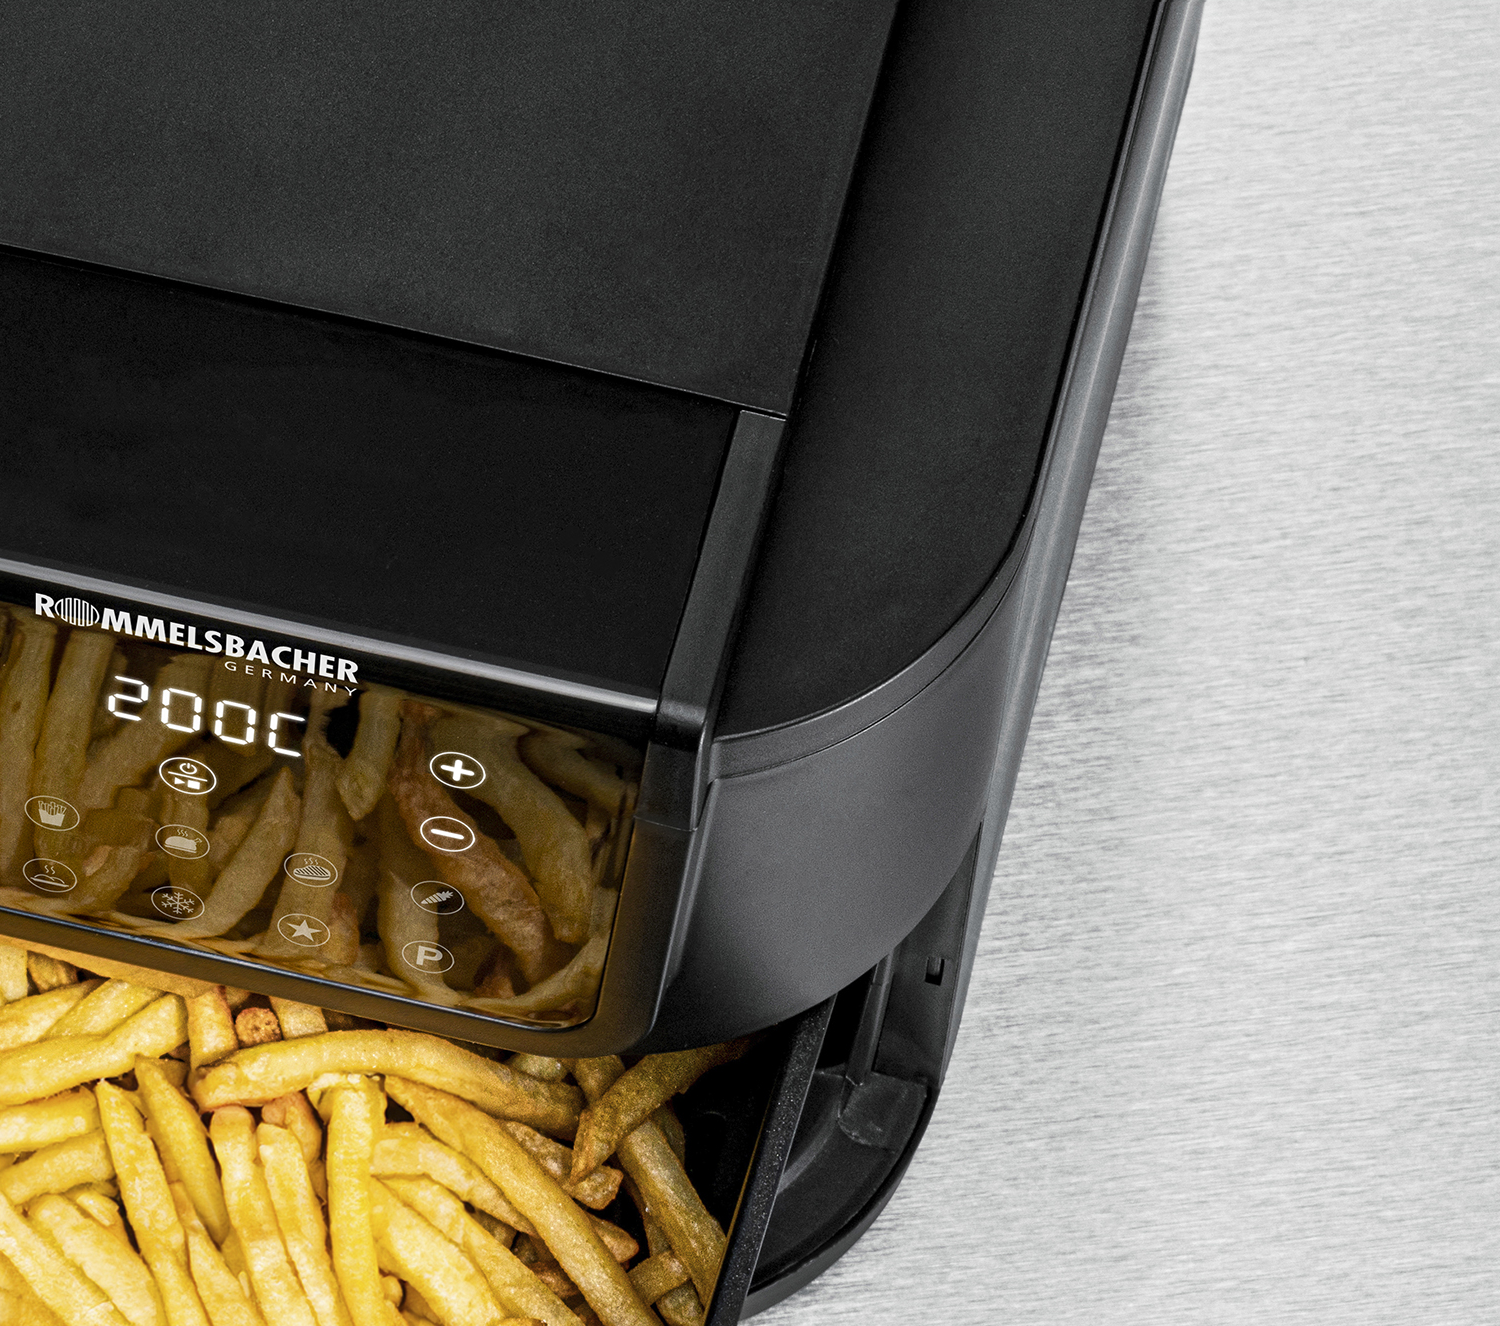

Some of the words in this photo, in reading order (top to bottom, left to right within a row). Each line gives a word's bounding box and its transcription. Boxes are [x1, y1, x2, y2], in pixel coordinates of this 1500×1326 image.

[34, 592, 359, 683] ROMMELSBACHER
[224, 660, 357, 697] GERMANY
[107, 675, 305, 758] 200C
[416, 945, 443, 966] P
